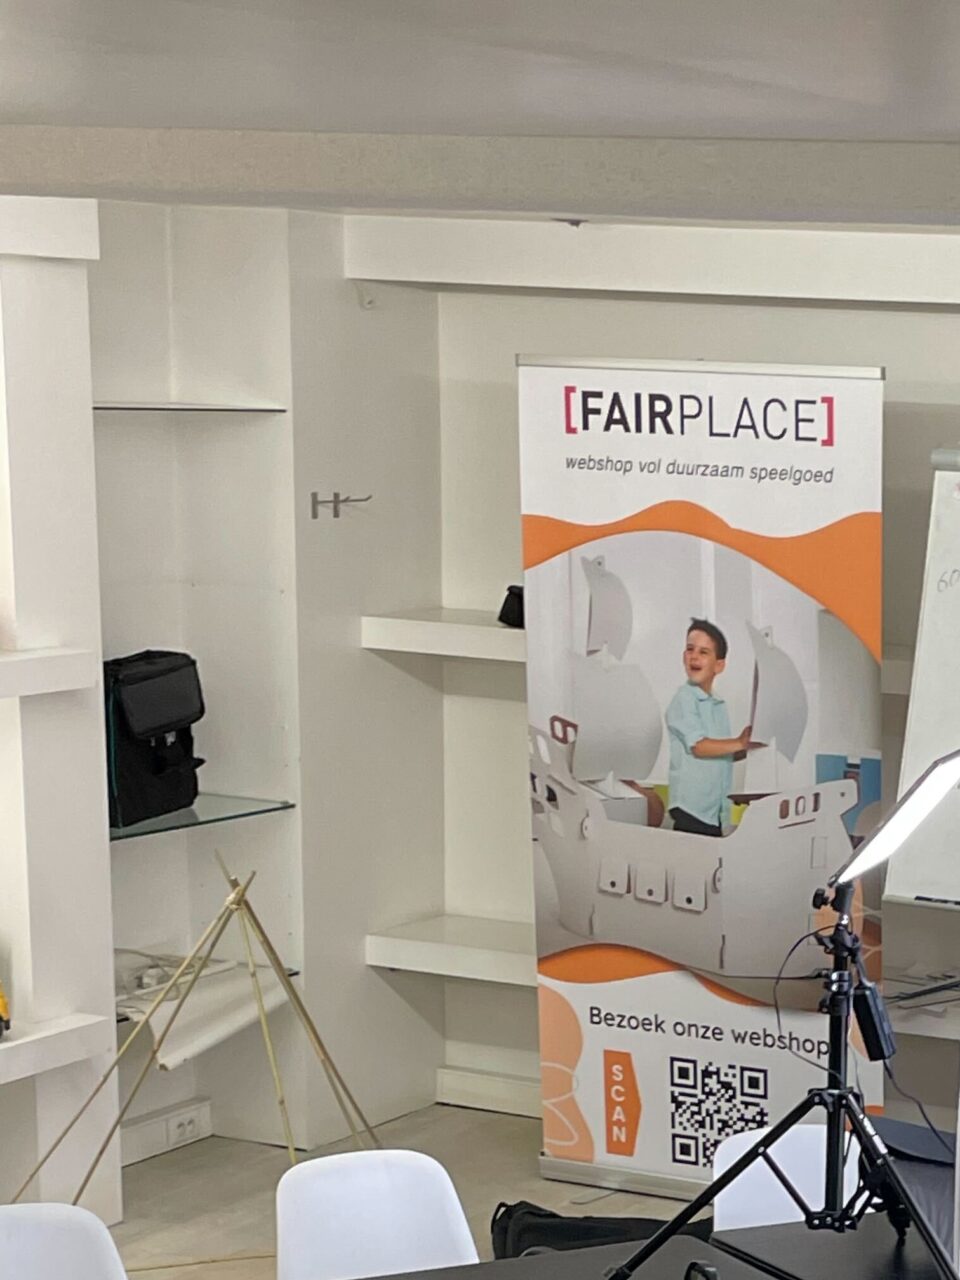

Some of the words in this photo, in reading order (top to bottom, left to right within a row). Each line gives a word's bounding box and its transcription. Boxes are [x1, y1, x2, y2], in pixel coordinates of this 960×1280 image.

[565, 455, 634, 475] webshop
[638, 457, 661, 474] vol
[665, 459, 744, 479] duurzaam
[749, 465, 834, 486] speelgoed
[589, 1006, 666, 1034] Bezoek
[673, 1021, 724, 1042] onze
[731, 1028, 830, 1059] webshop
[610, 1064, 627, 1143] SCAN
